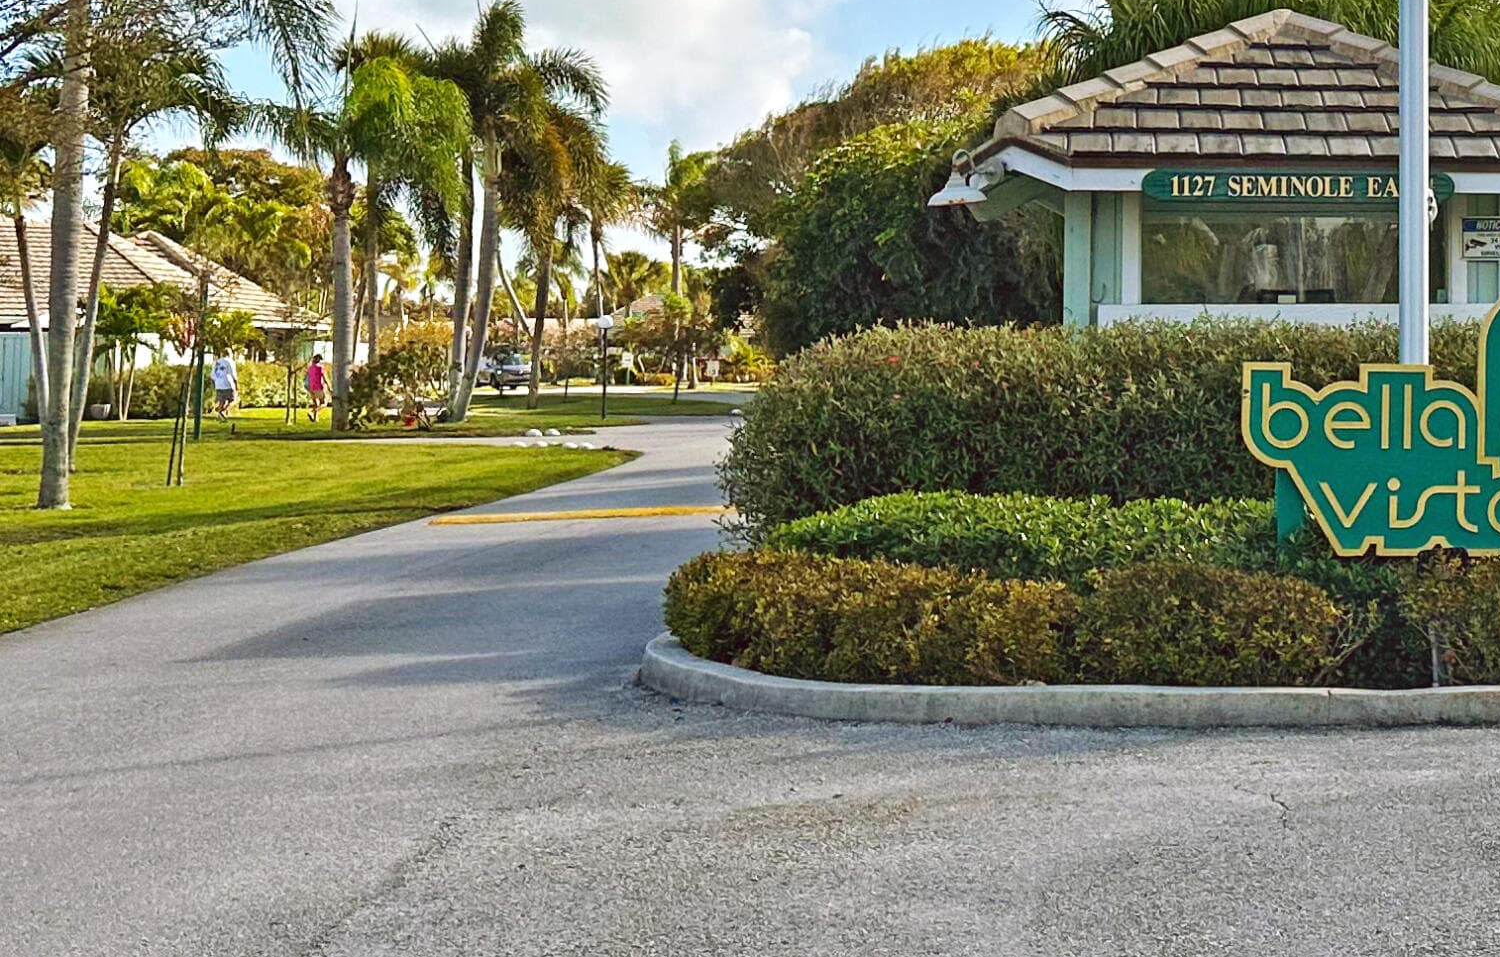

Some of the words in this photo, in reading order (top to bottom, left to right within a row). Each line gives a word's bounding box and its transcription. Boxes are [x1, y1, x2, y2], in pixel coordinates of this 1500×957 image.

[1170, 175, 1216, 197] 1127
[1227, 175, 1354, 197] SEMINOLE
[1261, 382, 1465, 450] bella
